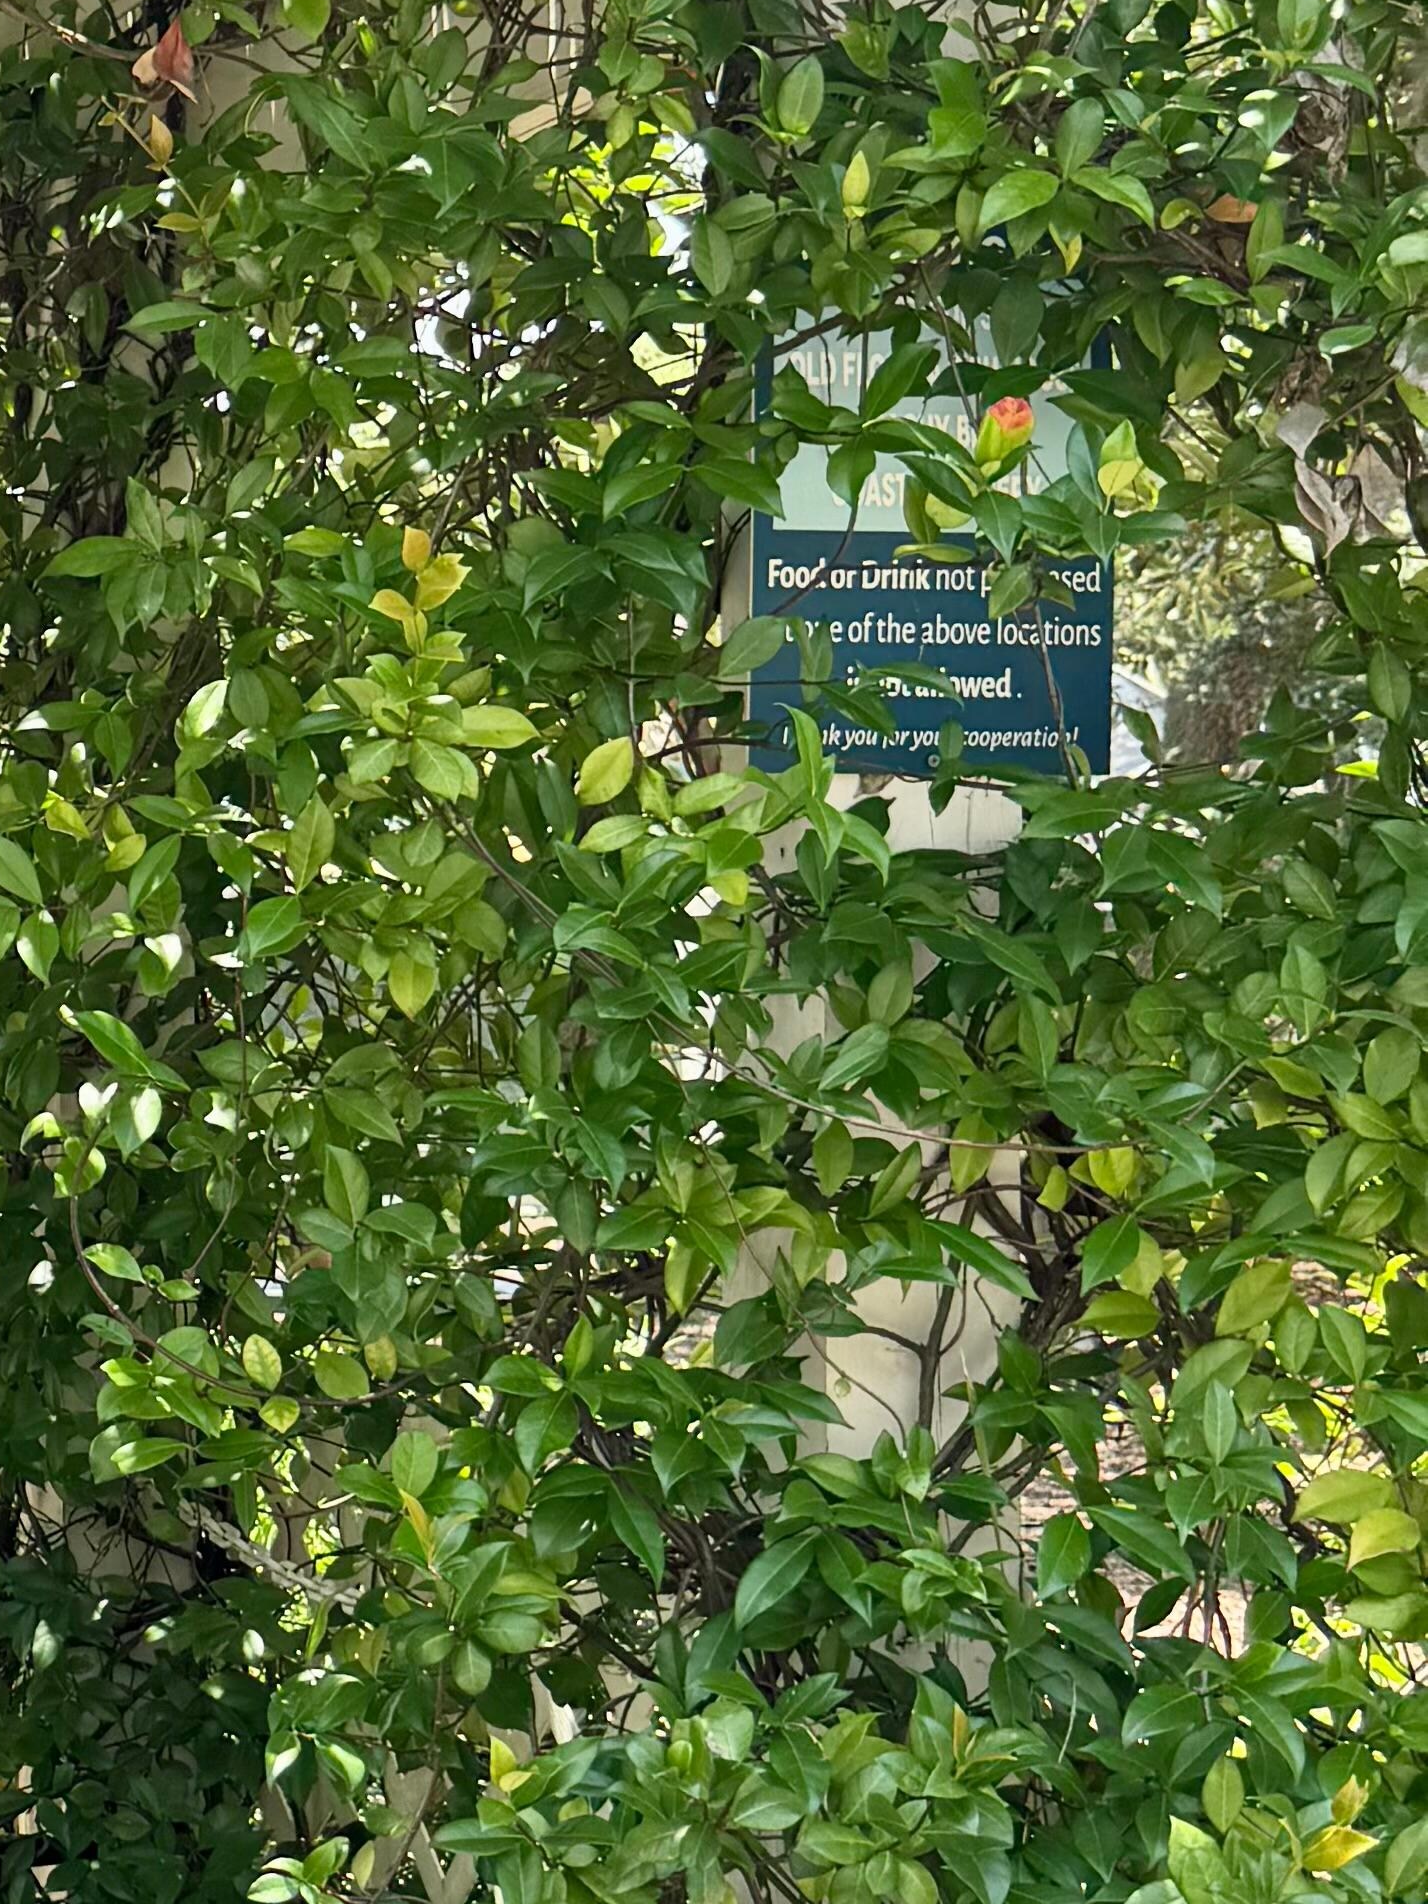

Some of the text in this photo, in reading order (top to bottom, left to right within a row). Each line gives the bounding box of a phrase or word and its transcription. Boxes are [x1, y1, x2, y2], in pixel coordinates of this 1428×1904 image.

[768, 557, 827, 589] Food
[830, 568, 857, 589] or
[861, 559, 931, 591] Drink
[935, 565, 976, 591] not
[848, 611, 875, 643] of
[877, 612, 916, 644] the
[921, 613, 991, 645] above
[997, 616, 1102, 646] locations
[840, 729, 878, 751] you
